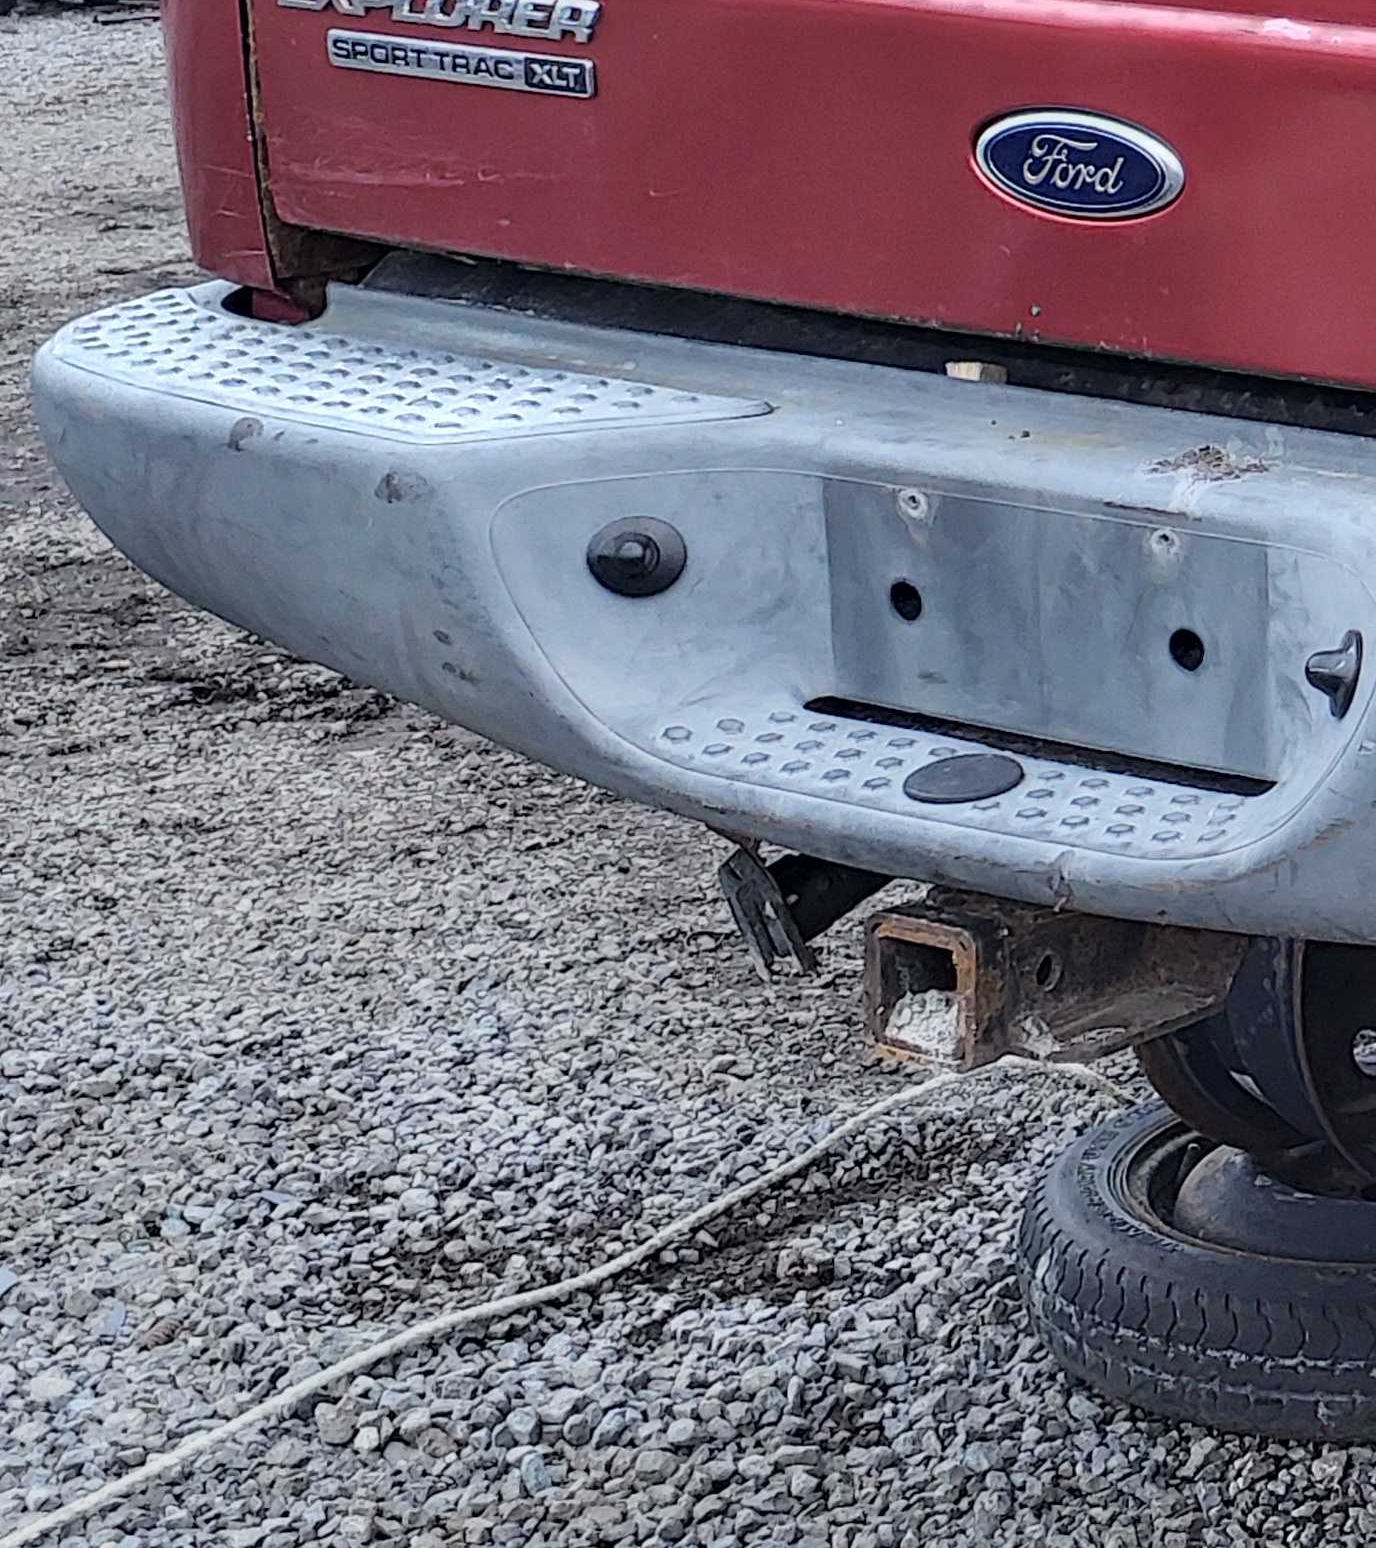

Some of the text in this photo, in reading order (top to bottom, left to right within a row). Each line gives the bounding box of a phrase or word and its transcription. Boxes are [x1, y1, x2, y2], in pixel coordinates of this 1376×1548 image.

[331, 37, 583, 91] SPORT TRAC XLT
[1022, 133, 1126, 195] Ford
